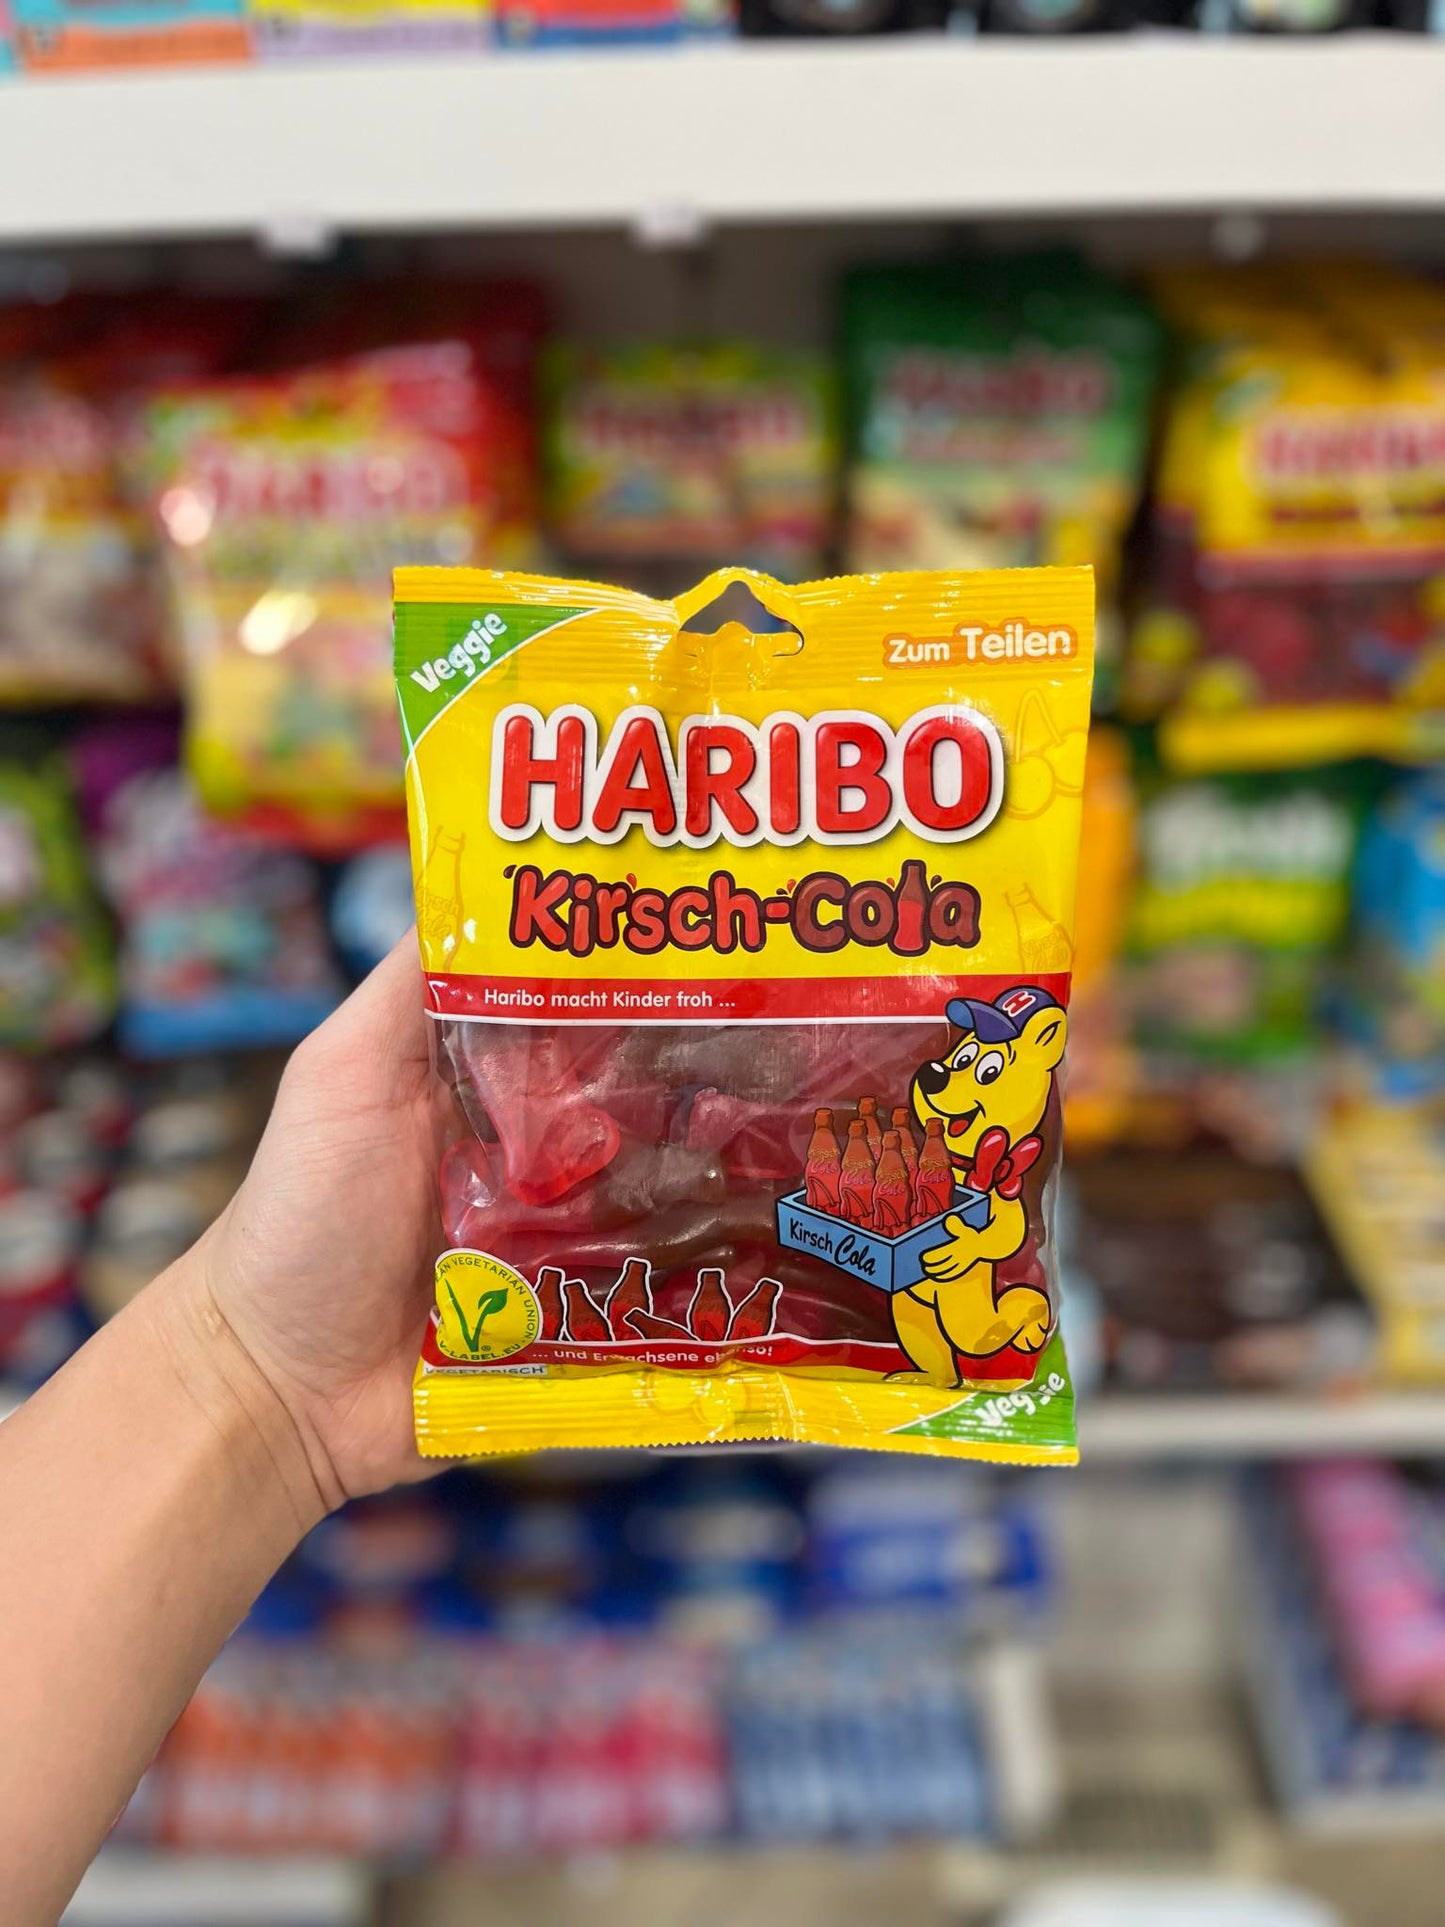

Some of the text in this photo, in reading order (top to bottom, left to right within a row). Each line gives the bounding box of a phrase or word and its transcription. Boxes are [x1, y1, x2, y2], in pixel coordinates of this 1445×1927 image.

[410, 613, 509, 693] Veggie
[888, 622, 1071, 664] Zum Teilen
[495, 708, 998, 842] HARIBO
[509, 860, 982, 957] Kirsch-Cola
[484, 988, 545, 1007] Haribo
[551, 991, 608, 1008] macht
[612, 990, 672, 1009] Kinder
[676, 991, 713, 1008] froh
[1002, 990, 1036, 1017] H
[789, 1217, 876, 1277] Kirsch Cola
[451, 1256, 527, 1296] VEGETARIAN
[523, 1299, 536, 1343] UNION
[554, 1350, 587, 1359] und
